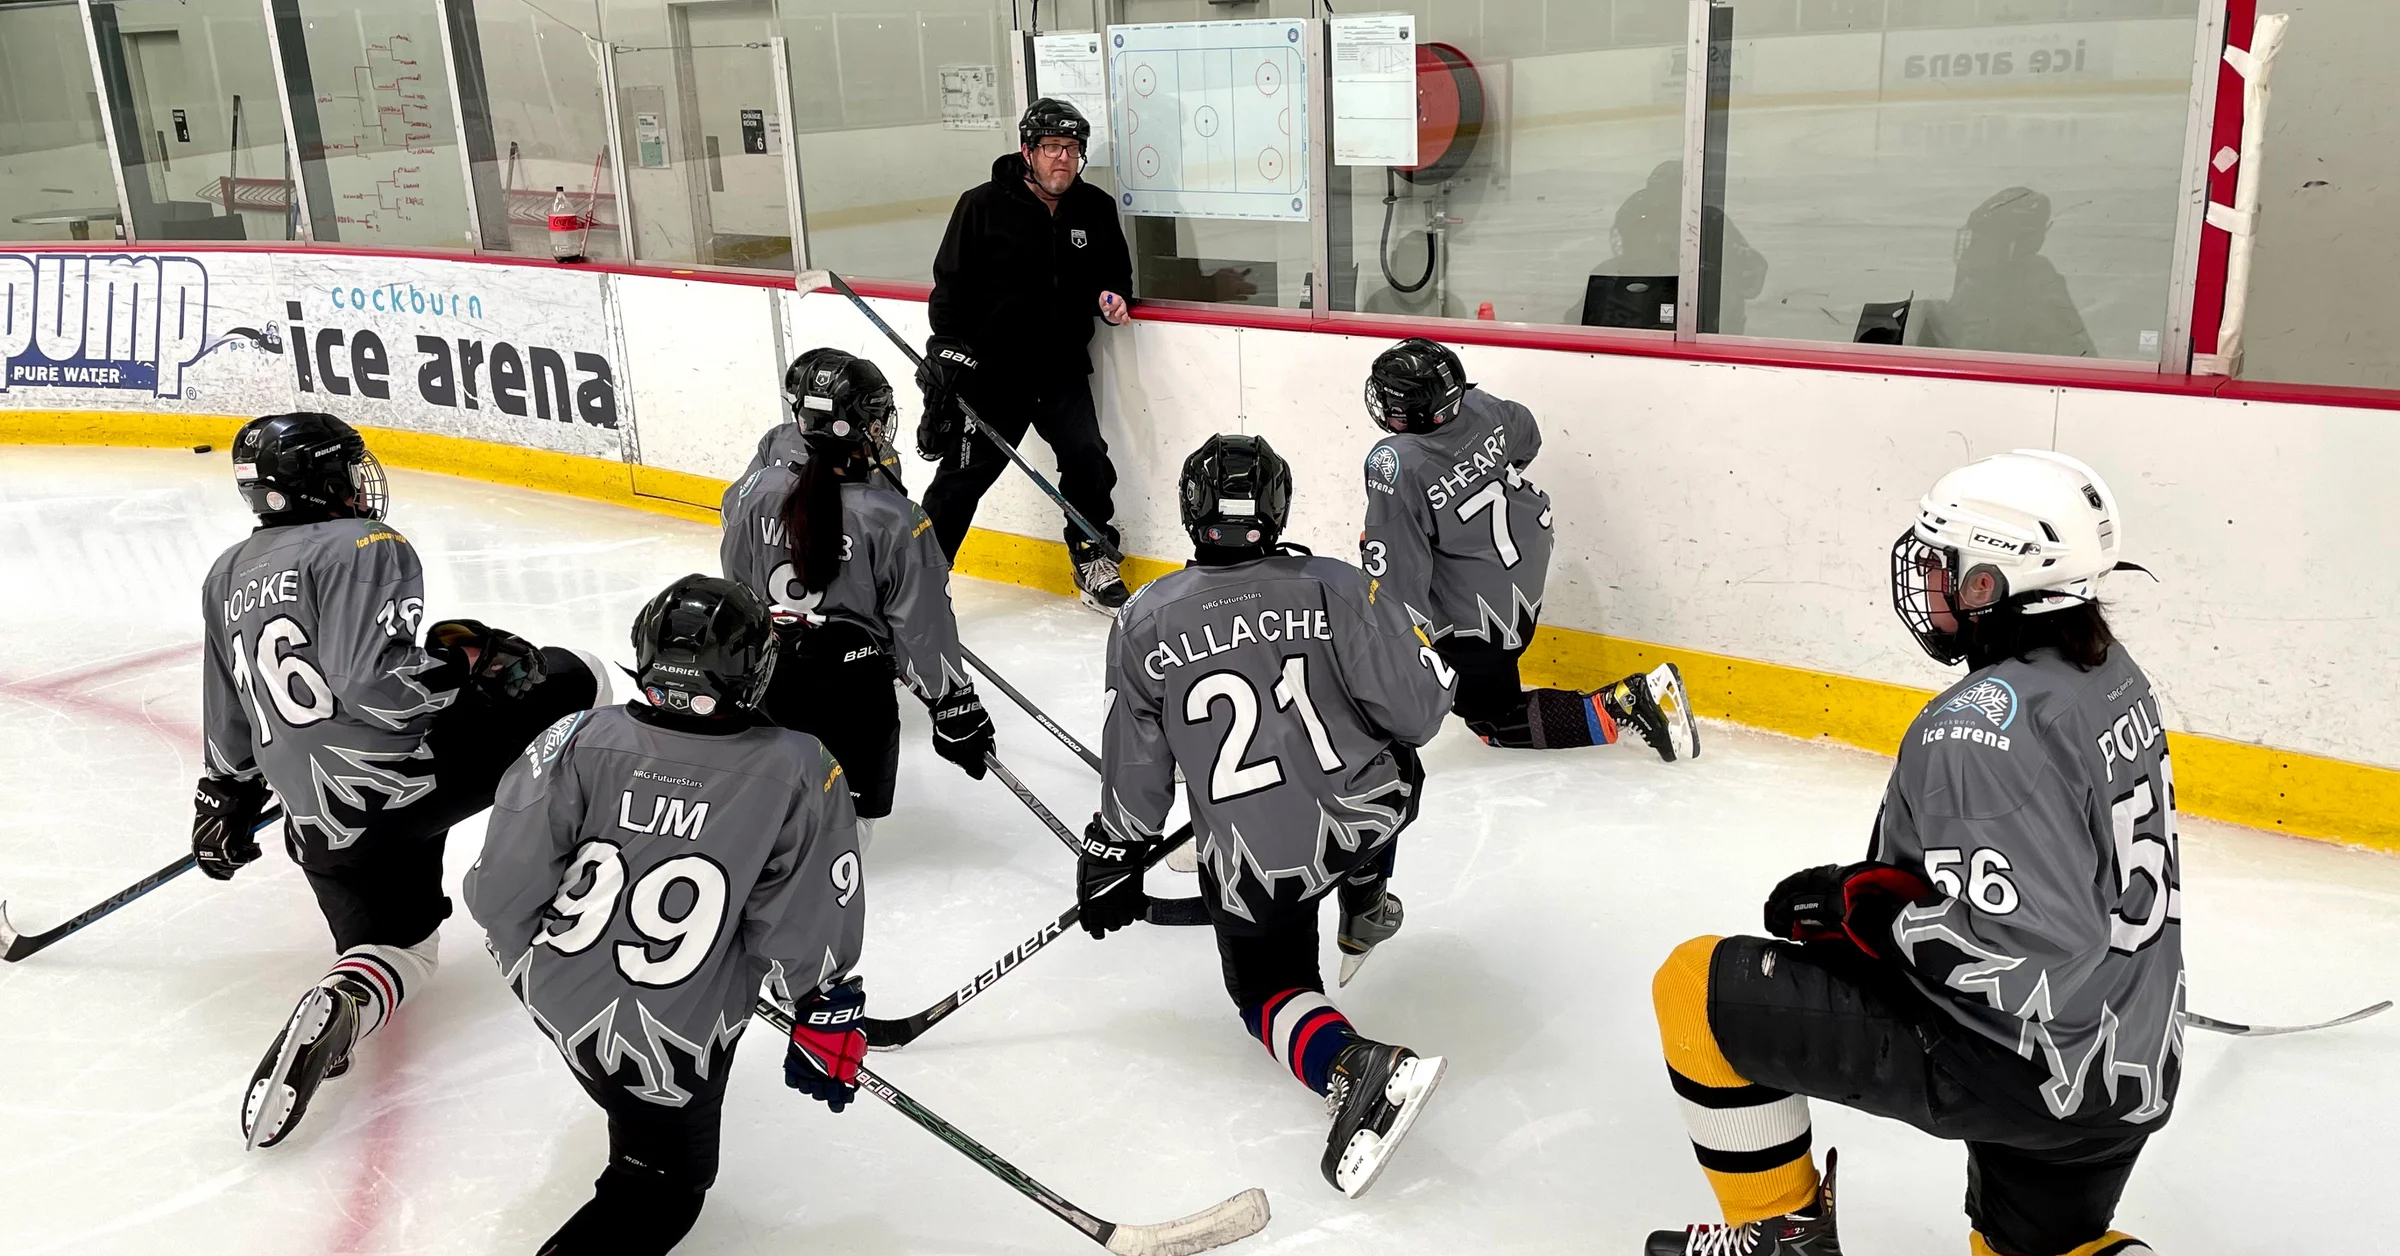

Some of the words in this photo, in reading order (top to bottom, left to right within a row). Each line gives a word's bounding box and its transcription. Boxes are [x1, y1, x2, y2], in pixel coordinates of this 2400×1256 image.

[757, 137, 764, 151] 6
[331, 284, 483, 319] cockburn
[13, 365, 59, 383] PURE
[64, 366, 121, 385] WATER
[286, 300, 391, 400] ice
[415, 334, 620, 431] arena
[300, 493, 327, 506] BUER
[1972, 533, 2018, 552] CCM
[1202, 600, 1219, 611] NRG
[652, 662, 701, 677] GABRIEL
[231, 613, 338, 748] 16
[2107, 687, 2122, 702] NRG
[1183, 653, 1347, 805] 21
[1934, 718, 1976, 727] cockburn
[1922, 727, 1945, 746] ice
[1950, 727, 2011, 751] arena
[633, 768, 650, 780] NRG
[652, 771, 704, 789] FutureStars
[1923, 846, 2021, 916] 56
[530, 837, 731, 989] 99
